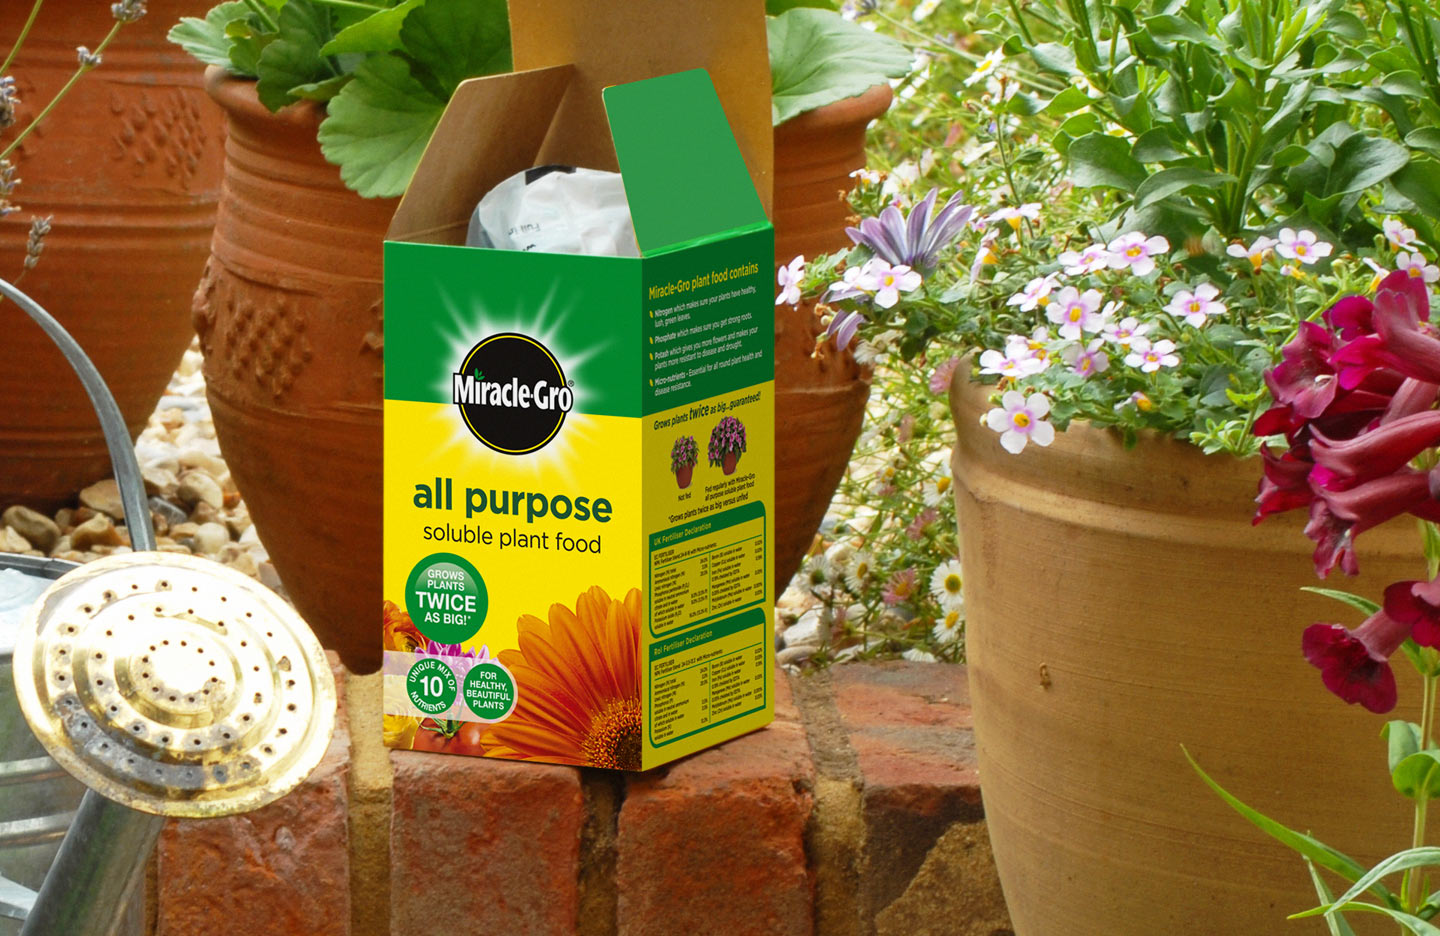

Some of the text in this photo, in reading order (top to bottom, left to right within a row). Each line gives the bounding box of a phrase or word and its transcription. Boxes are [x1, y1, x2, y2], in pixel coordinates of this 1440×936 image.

[649, 262, 759, 300] Miracle-Gro plant food contains
[709, 296, 718, 305] your
[712, 321, 720, 330] you
[693, 342, 701, 351] you
[749, 326, 758, 336] your
[717, 344, 725, 353] and
[453, 373, 573, 412] Miracle-Gro
[654, 419, 671, 430] Grows
[671, 412, 688, 426] plants
[689, 404, 709, 420] twice
[710, 405, 716, 415] as
[413, 477, 613, 524] all purpose
[684, 508, 697, 518] plants
[697, 505, 709, 514] twice
[709, 503, 715, 511] as
[423, 523, 601, 553] soluble plant food
[662, 530, 684, 543] Fertiliser
[685, 522, 712, 536] Declaration
[427, 569, 465, 581] GROWS
[427, 580, 465, 591] PLANTS
[415, 591, 477, 612] TWICE
[424, 611, 441, 624] AS
[663, 640, 684, 652] Fertiliser
[685, 630, 713, 645] Declaration
[409, 661, 456, 692] UNIQUE MIX OF
[420, 675, 444, 697] 10
[470, 680, 508, 692] HEALTHY,
[480, 671, 497, 680] FOR
[410, 691, 447, 712] NUTRIENTS
[466, 689, 511, 701] BEAUTIFUL
[473, 700, 504, 710] PLANTS
